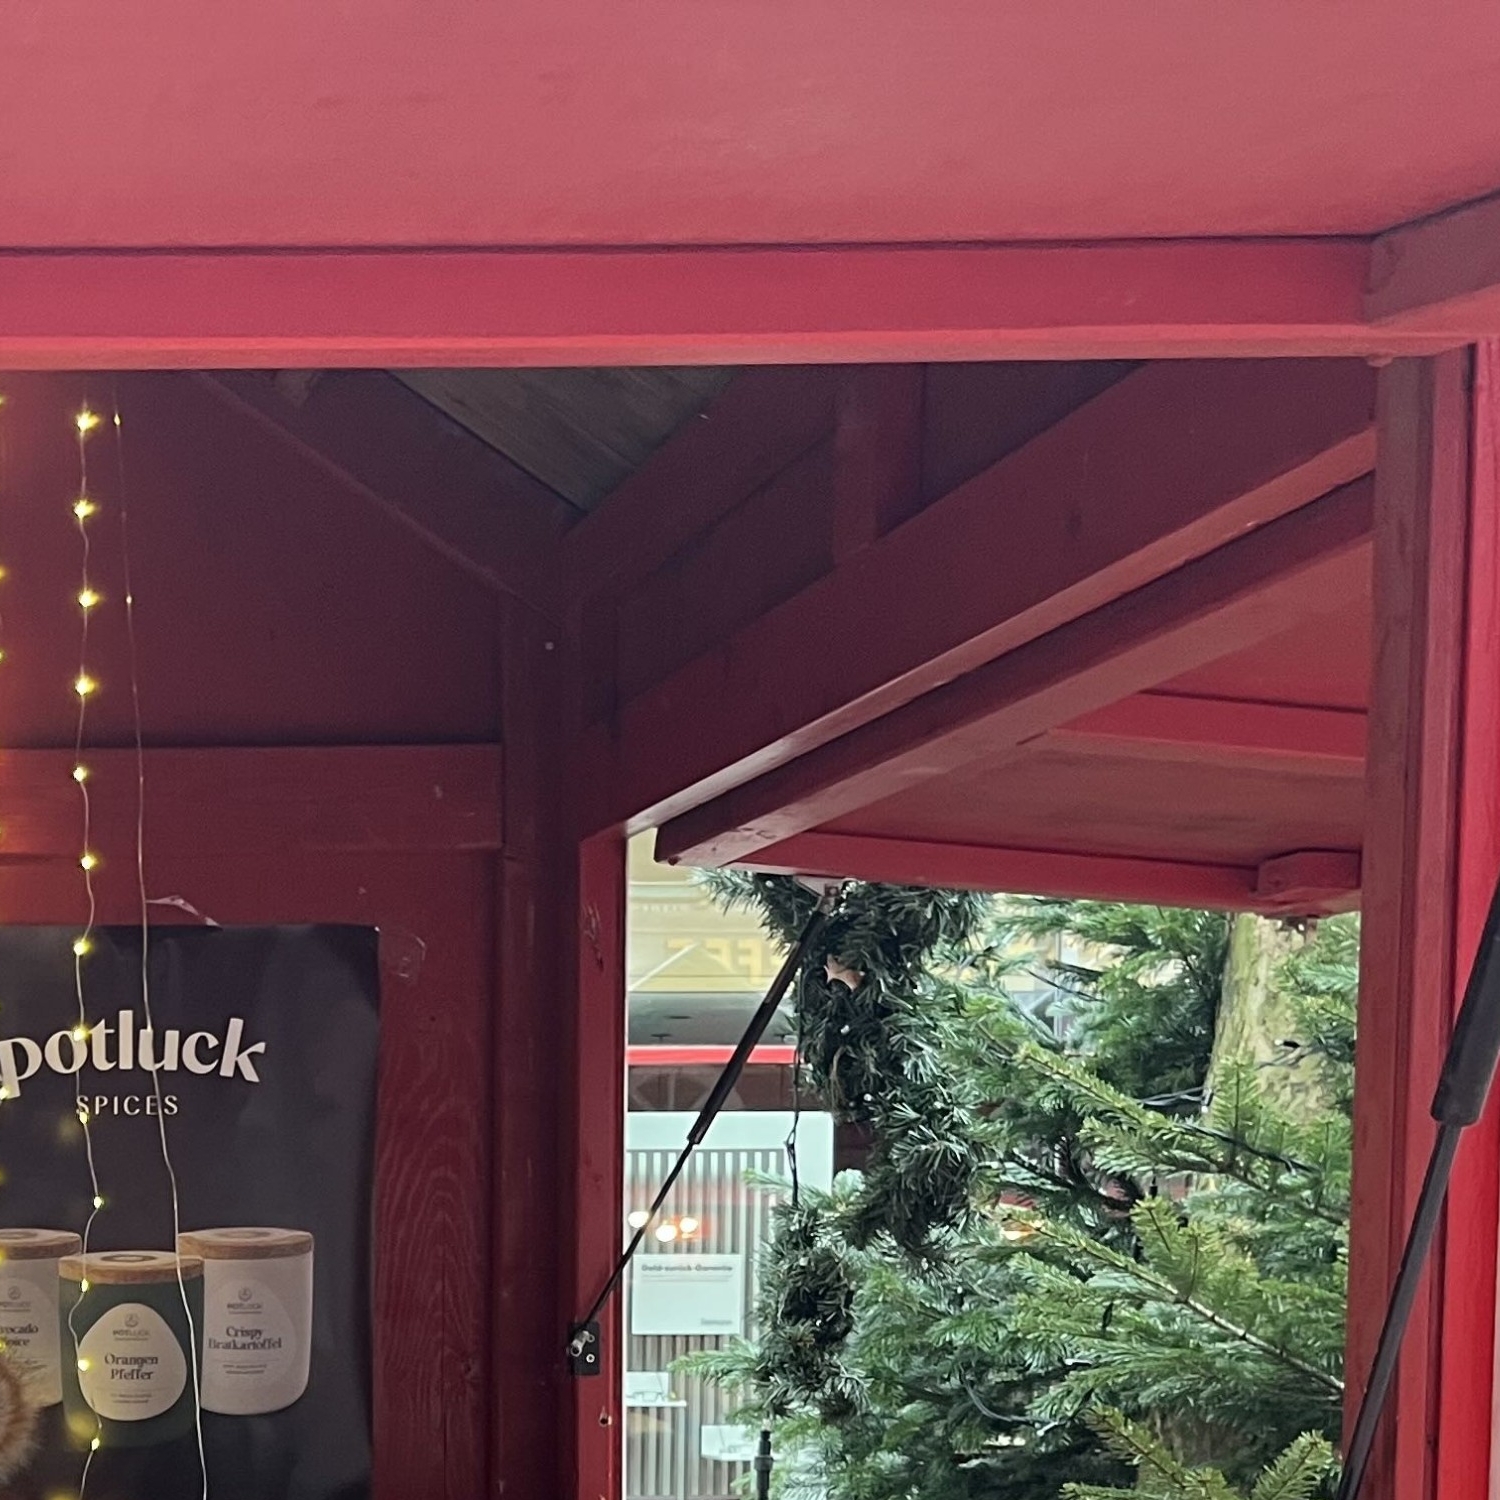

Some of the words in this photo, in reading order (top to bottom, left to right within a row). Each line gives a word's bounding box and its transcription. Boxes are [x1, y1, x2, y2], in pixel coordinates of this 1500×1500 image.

[76, 1095, 179, 1117] SPICES
[225, 1326, 265, 1341] Crispy
[208, 1337, 283, 1350] Bratkartoffel
[104, 1355, 159, 1368] Orangen
[110, 1369, 154, 1381] Pfeffer
